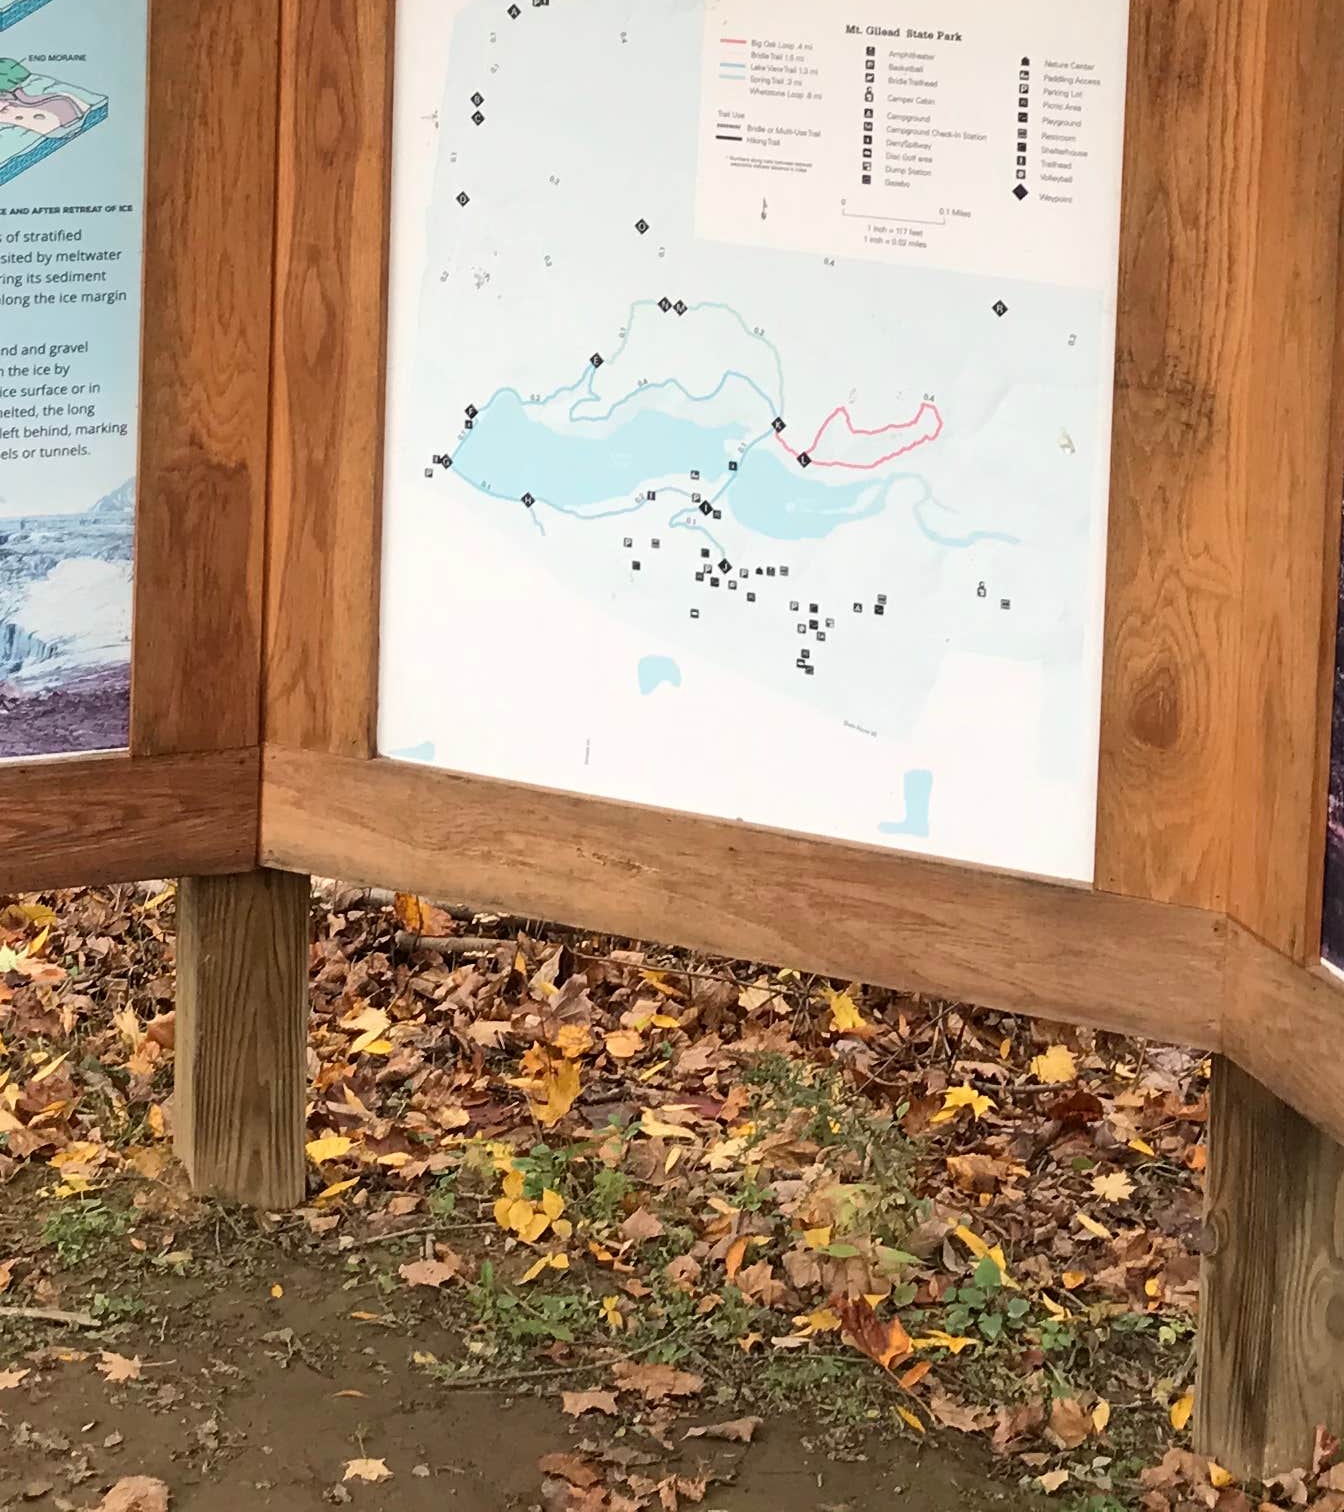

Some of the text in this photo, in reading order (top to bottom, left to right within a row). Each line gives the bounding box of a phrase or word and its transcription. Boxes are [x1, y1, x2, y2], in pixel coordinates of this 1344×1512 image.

[845, 24, 962, 42] Mt. Gilead State Park
[9, 207, 30, 215] AND
[31, 206, 61, 215] AFTER
[62, 205, 103, 214] RETREAT
[104, 205, 117, 213] OF
[118, 204, 133, 212] ICE
[5, 230, 21, 244] of
[23, 228, 82, 243] stratified
